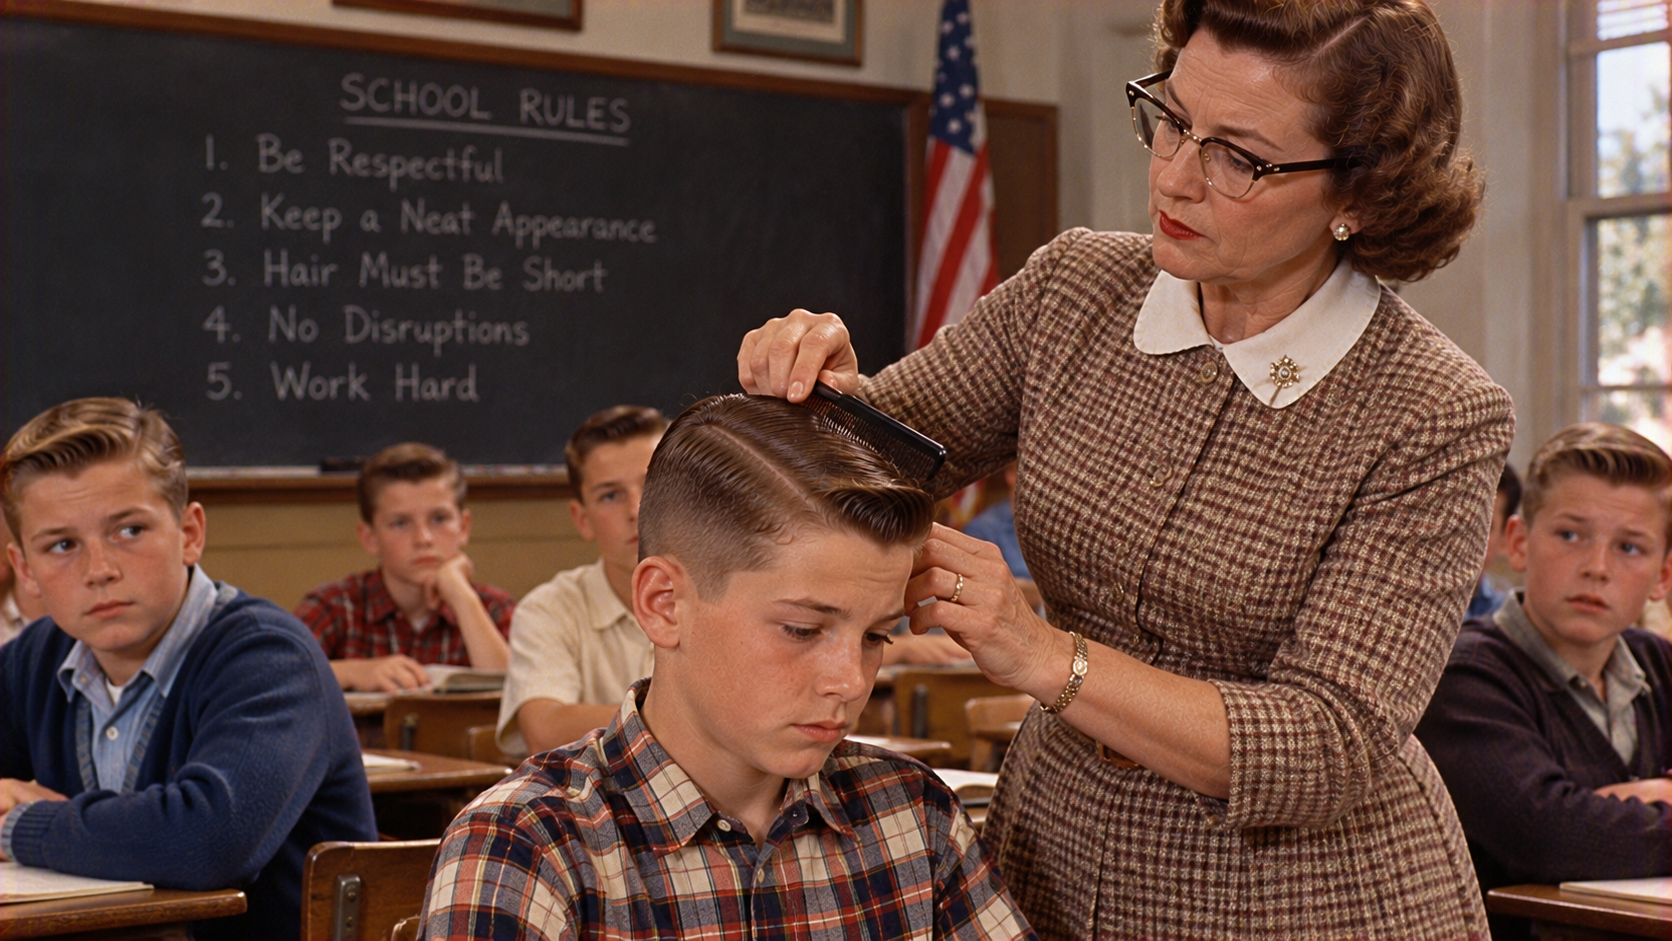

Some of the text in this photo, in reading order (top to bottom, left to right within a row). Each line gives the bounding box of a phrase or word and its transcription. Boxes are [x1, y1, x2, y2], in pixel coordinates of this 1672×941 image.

[340, 72, 631, 133] SCHOOL RULES
[205, 133, 504, 191] 1. Be Respectful
[201, 192, 659, 249] 2. Keep a Neat Appearance
[202, 248, 609, 293] 3. Hair Must Be Short
[203, 305, 530, 357] 4. No Disruptions
[207, 361, 480, 402] 5. Work Hard
